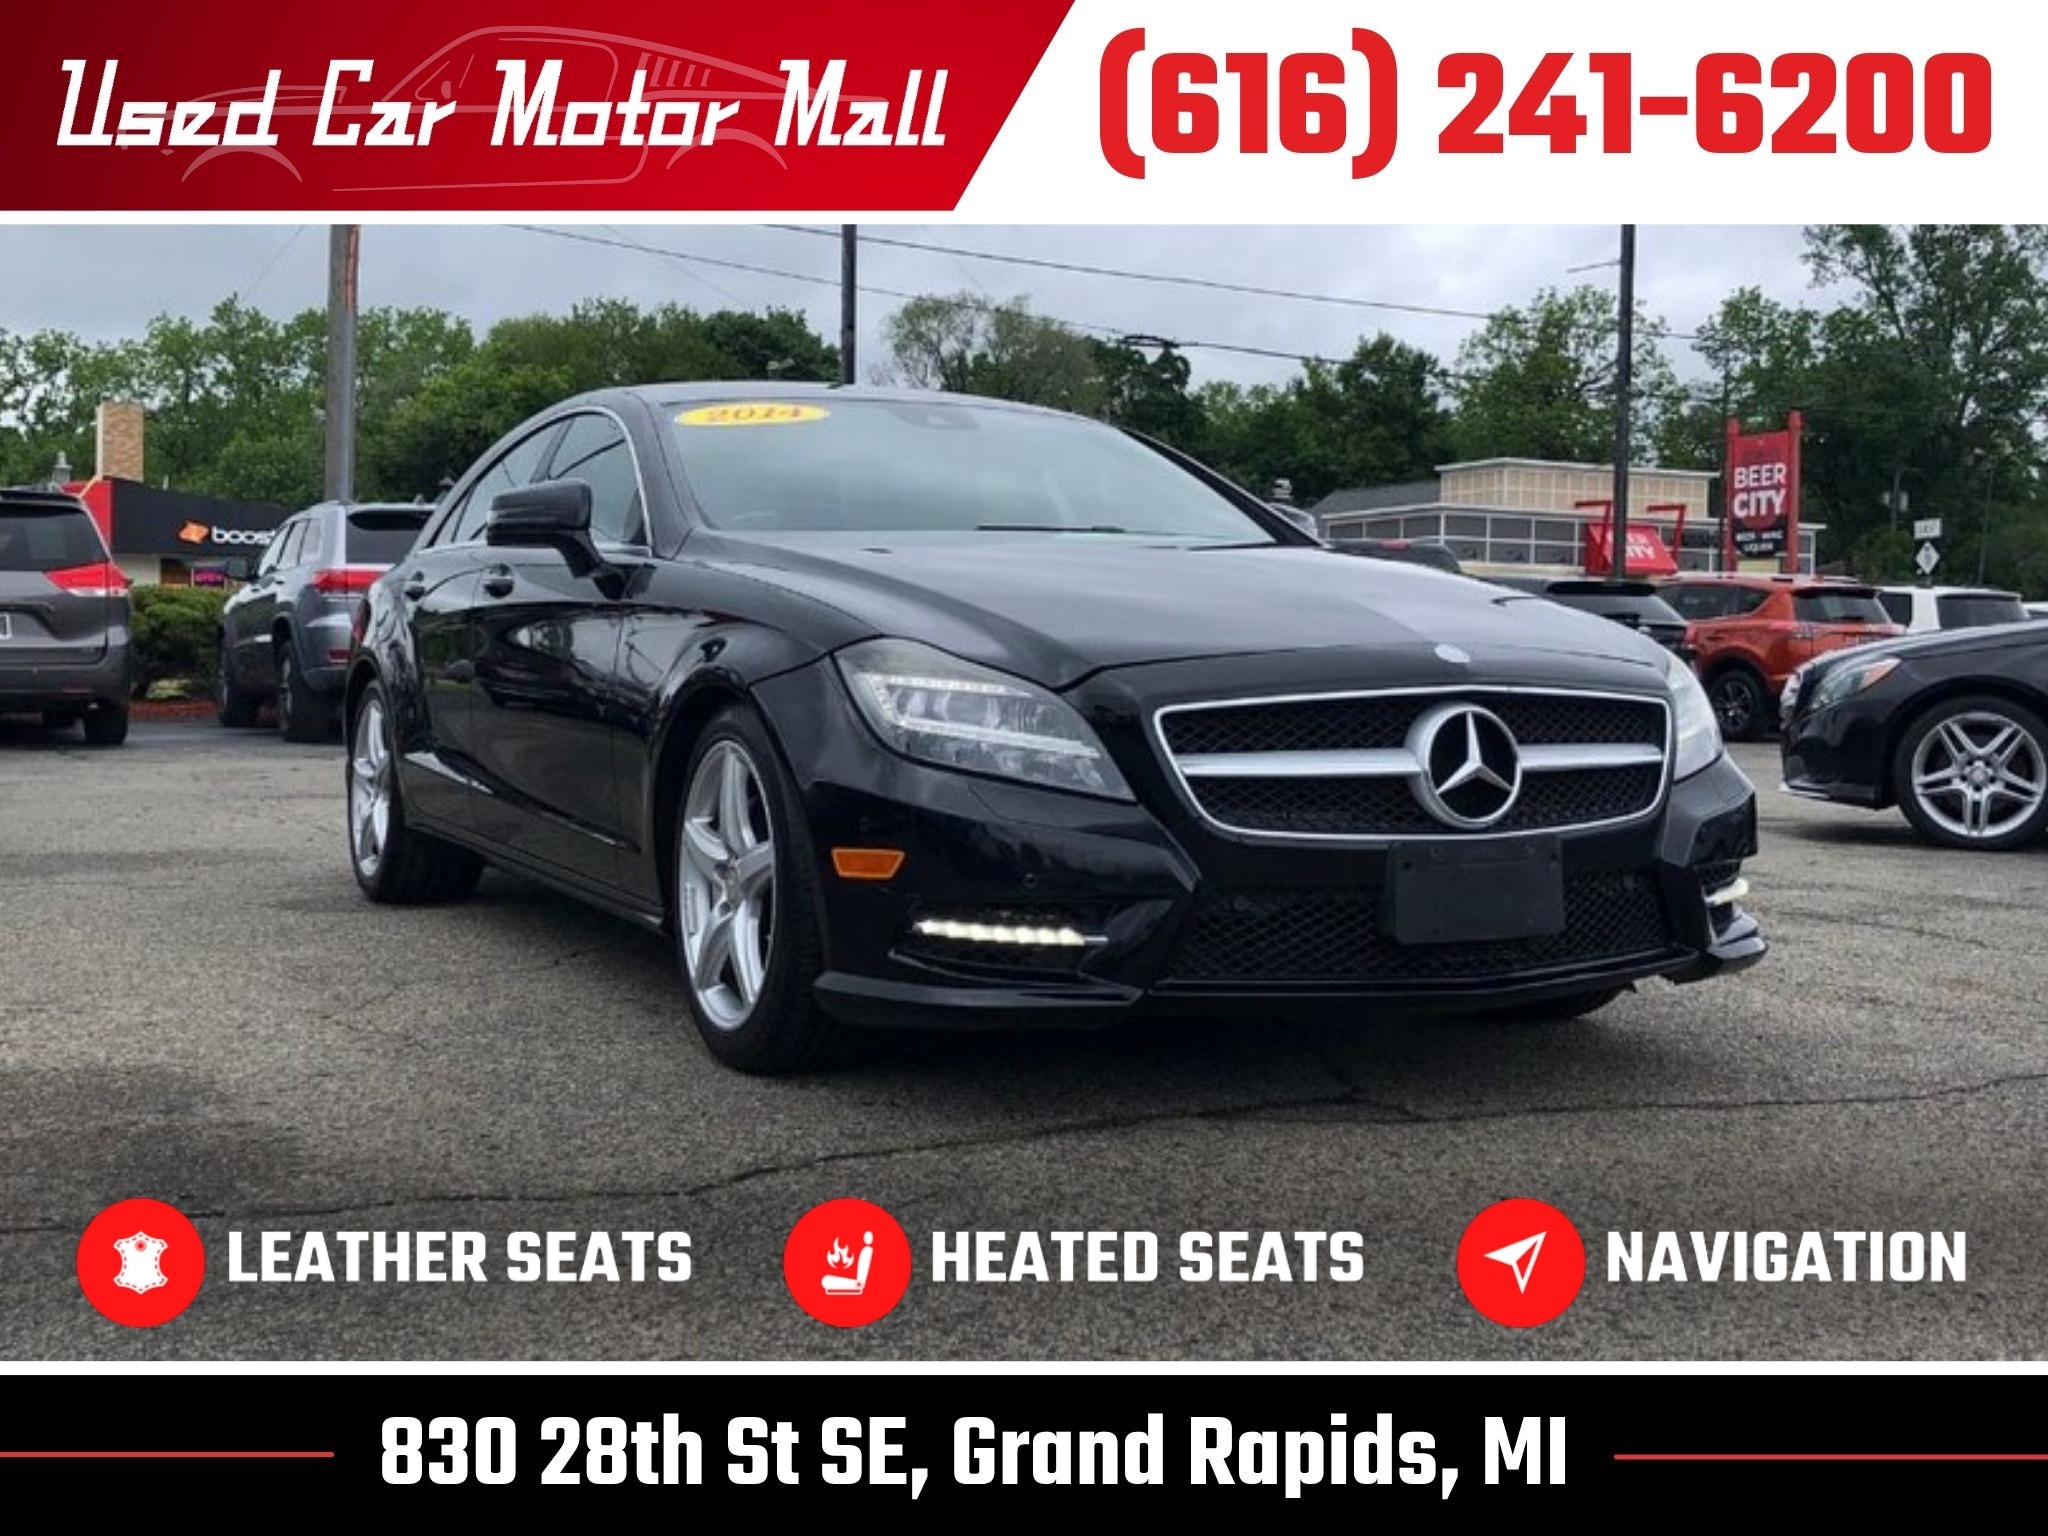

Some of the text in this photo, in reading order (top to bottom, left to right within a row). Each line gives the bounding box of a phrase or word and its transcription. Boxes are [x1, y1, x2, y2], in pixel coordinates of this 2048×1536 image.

[707, 404, 804, 423] 2014
[1734, 463, 1787, 488] BEER
[1734, 488, 1787, 517] CITY
[211, 526, 277, 543] boos
